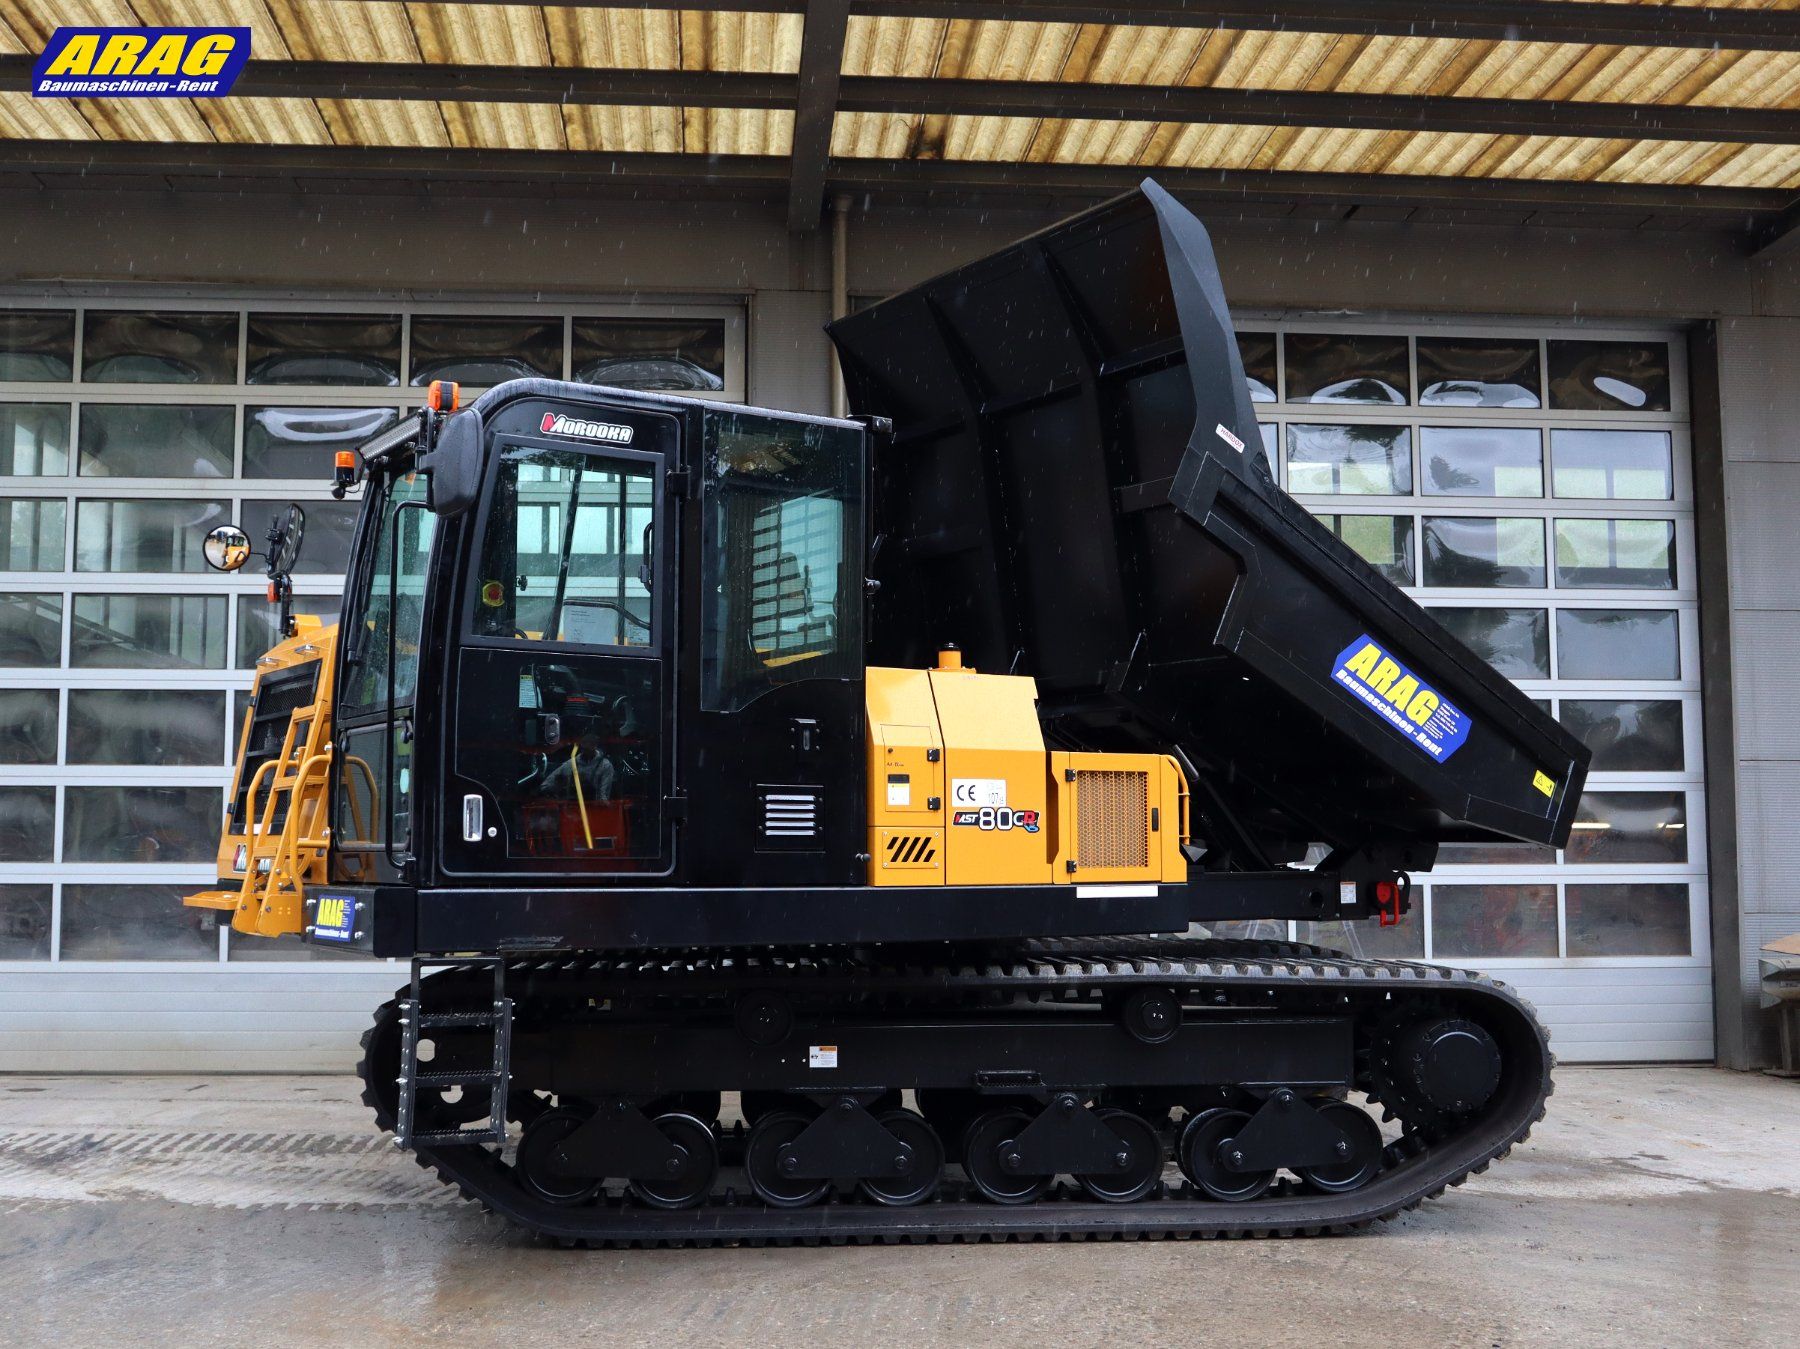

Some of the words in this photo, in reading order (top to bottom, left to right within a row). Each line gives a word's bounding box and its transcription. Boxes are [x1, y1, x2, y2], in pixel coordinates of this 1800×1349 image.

[541, 412, 633, 444] MOROOKA
[1220, 427, 1243, 448] HARDOX
[1344, 642, 1439, 727] ARAG
[956, 784, 976, 801] CE
[317, 898, 344, 927] ARAG
